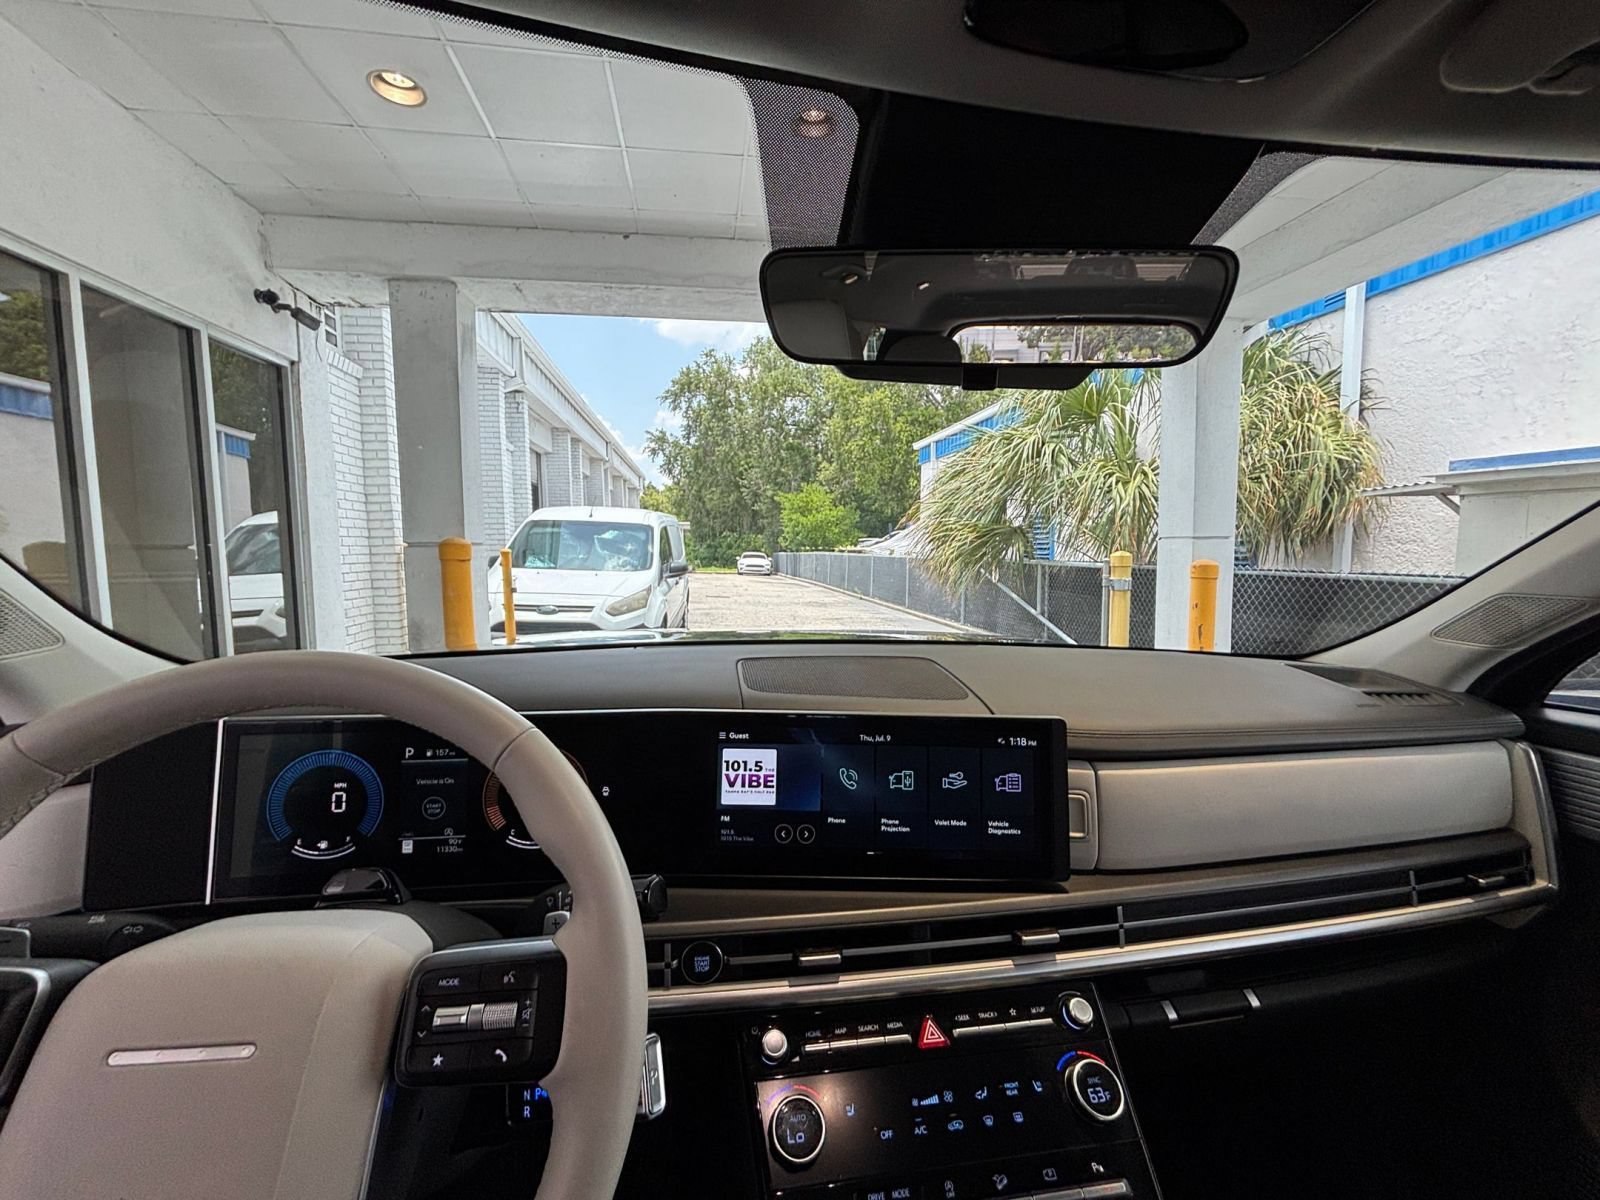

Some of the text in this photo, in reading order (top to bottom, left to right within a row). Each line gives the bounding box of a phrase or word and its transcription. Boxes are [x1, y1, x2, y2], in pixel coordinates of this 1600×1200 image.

[860, 734, 874, 743] Thu,
[1009, 737, 1027, 746] 1:18
[405, 747, 414, 759] P
[724, 760, 763, 772] 101.5
[724, 773, 775, 788] VIBE
[331, 791, 346, 813] 0
[881, 825, 910, 833] Projection
[988, 820, 1009, 828] Vehicle
[988, 827, 1021, 835] Diagnostics
[438, 977, 460, 986] MODE
[858, 1023, 879, 1033] SEARCH
[887, 1021, 903, 1029] MEDIA
[805, 1030, 822, 1038] HOME
[835, 1027, 847, 1035] MAP
[524, 1090, 531, 1101] N
[535, 1087, 542, 1100] P
[524, 1106, 531, 1118] R
[789, 1113, 807, 1122] AUTO
[880, 1129, 894, 1140] OFF
[914, 1125, 928, 1135] A/C
[787, 1128, 805, 1144] Lo
[868, 1187, 911, 1200] DRIVE MODE
